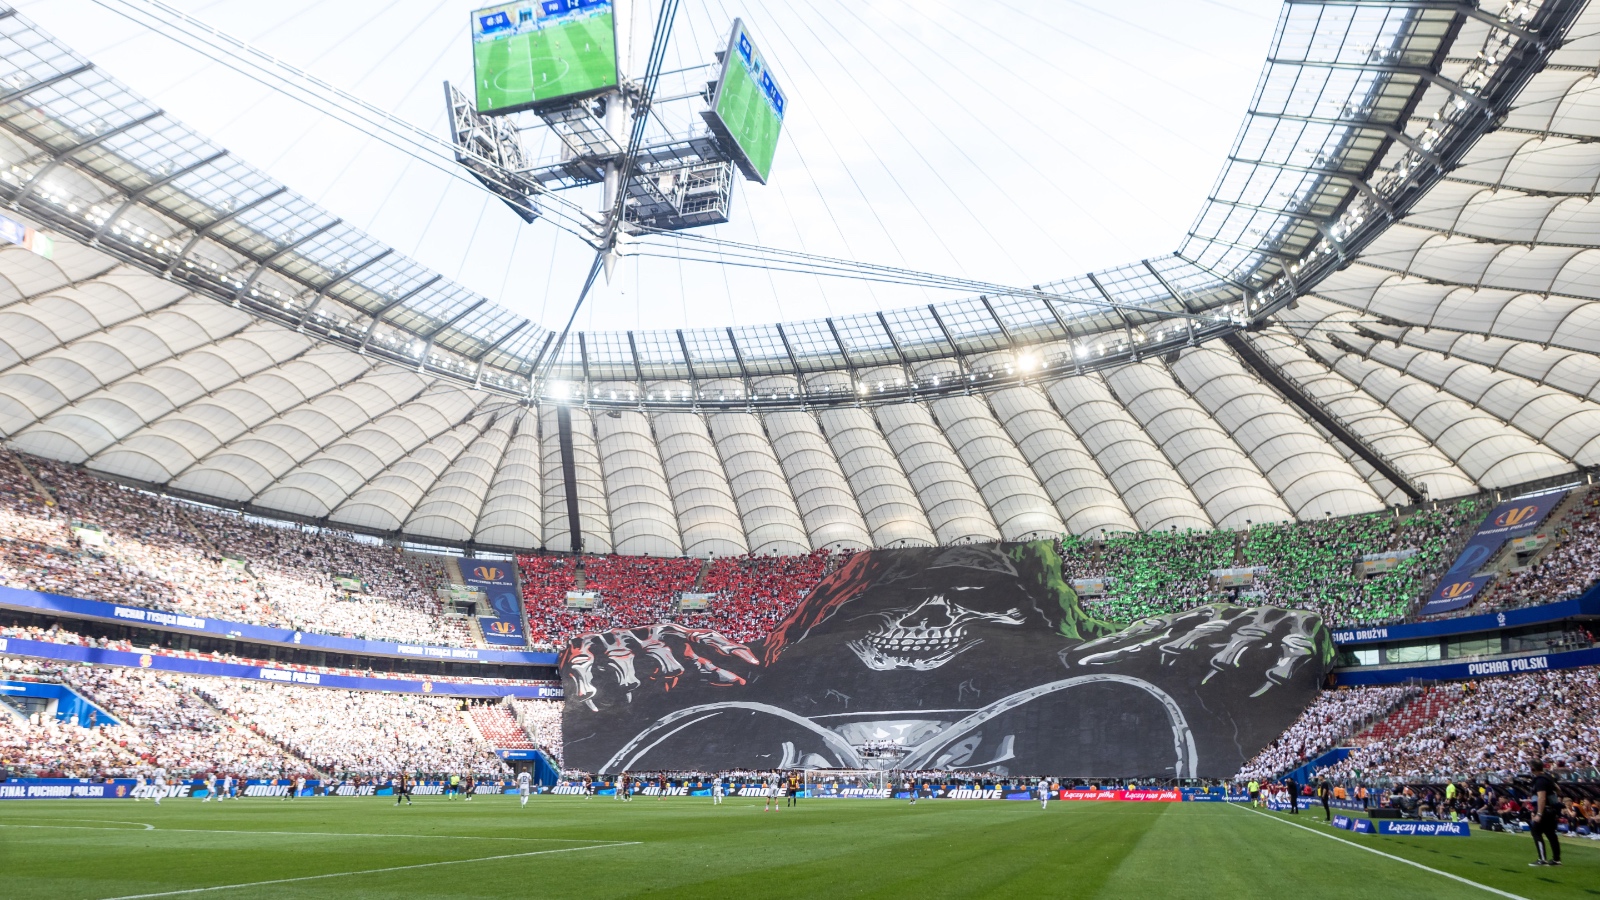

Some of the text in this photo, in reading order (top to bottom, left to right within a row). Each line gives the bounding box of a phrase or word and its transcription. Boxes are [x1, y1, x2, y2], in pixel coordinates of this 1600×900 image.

[1356, 628, 1388, 640] DRUŻYN
[1468, 656, 1548, 675] PUCHAR POLSKI
[0, 785, 26, 797] FINAŁ
[28, 785, 72, 797] PUCHARU
[410, 785, 445, 795] 4MOVE
[474, 786, 502, 794] 4MOVE
[946, 789, 1003, 799] 4MOVE
[1388, 821, 1416, 834] Łączy
[1417, 822, 1434, 832] nas
